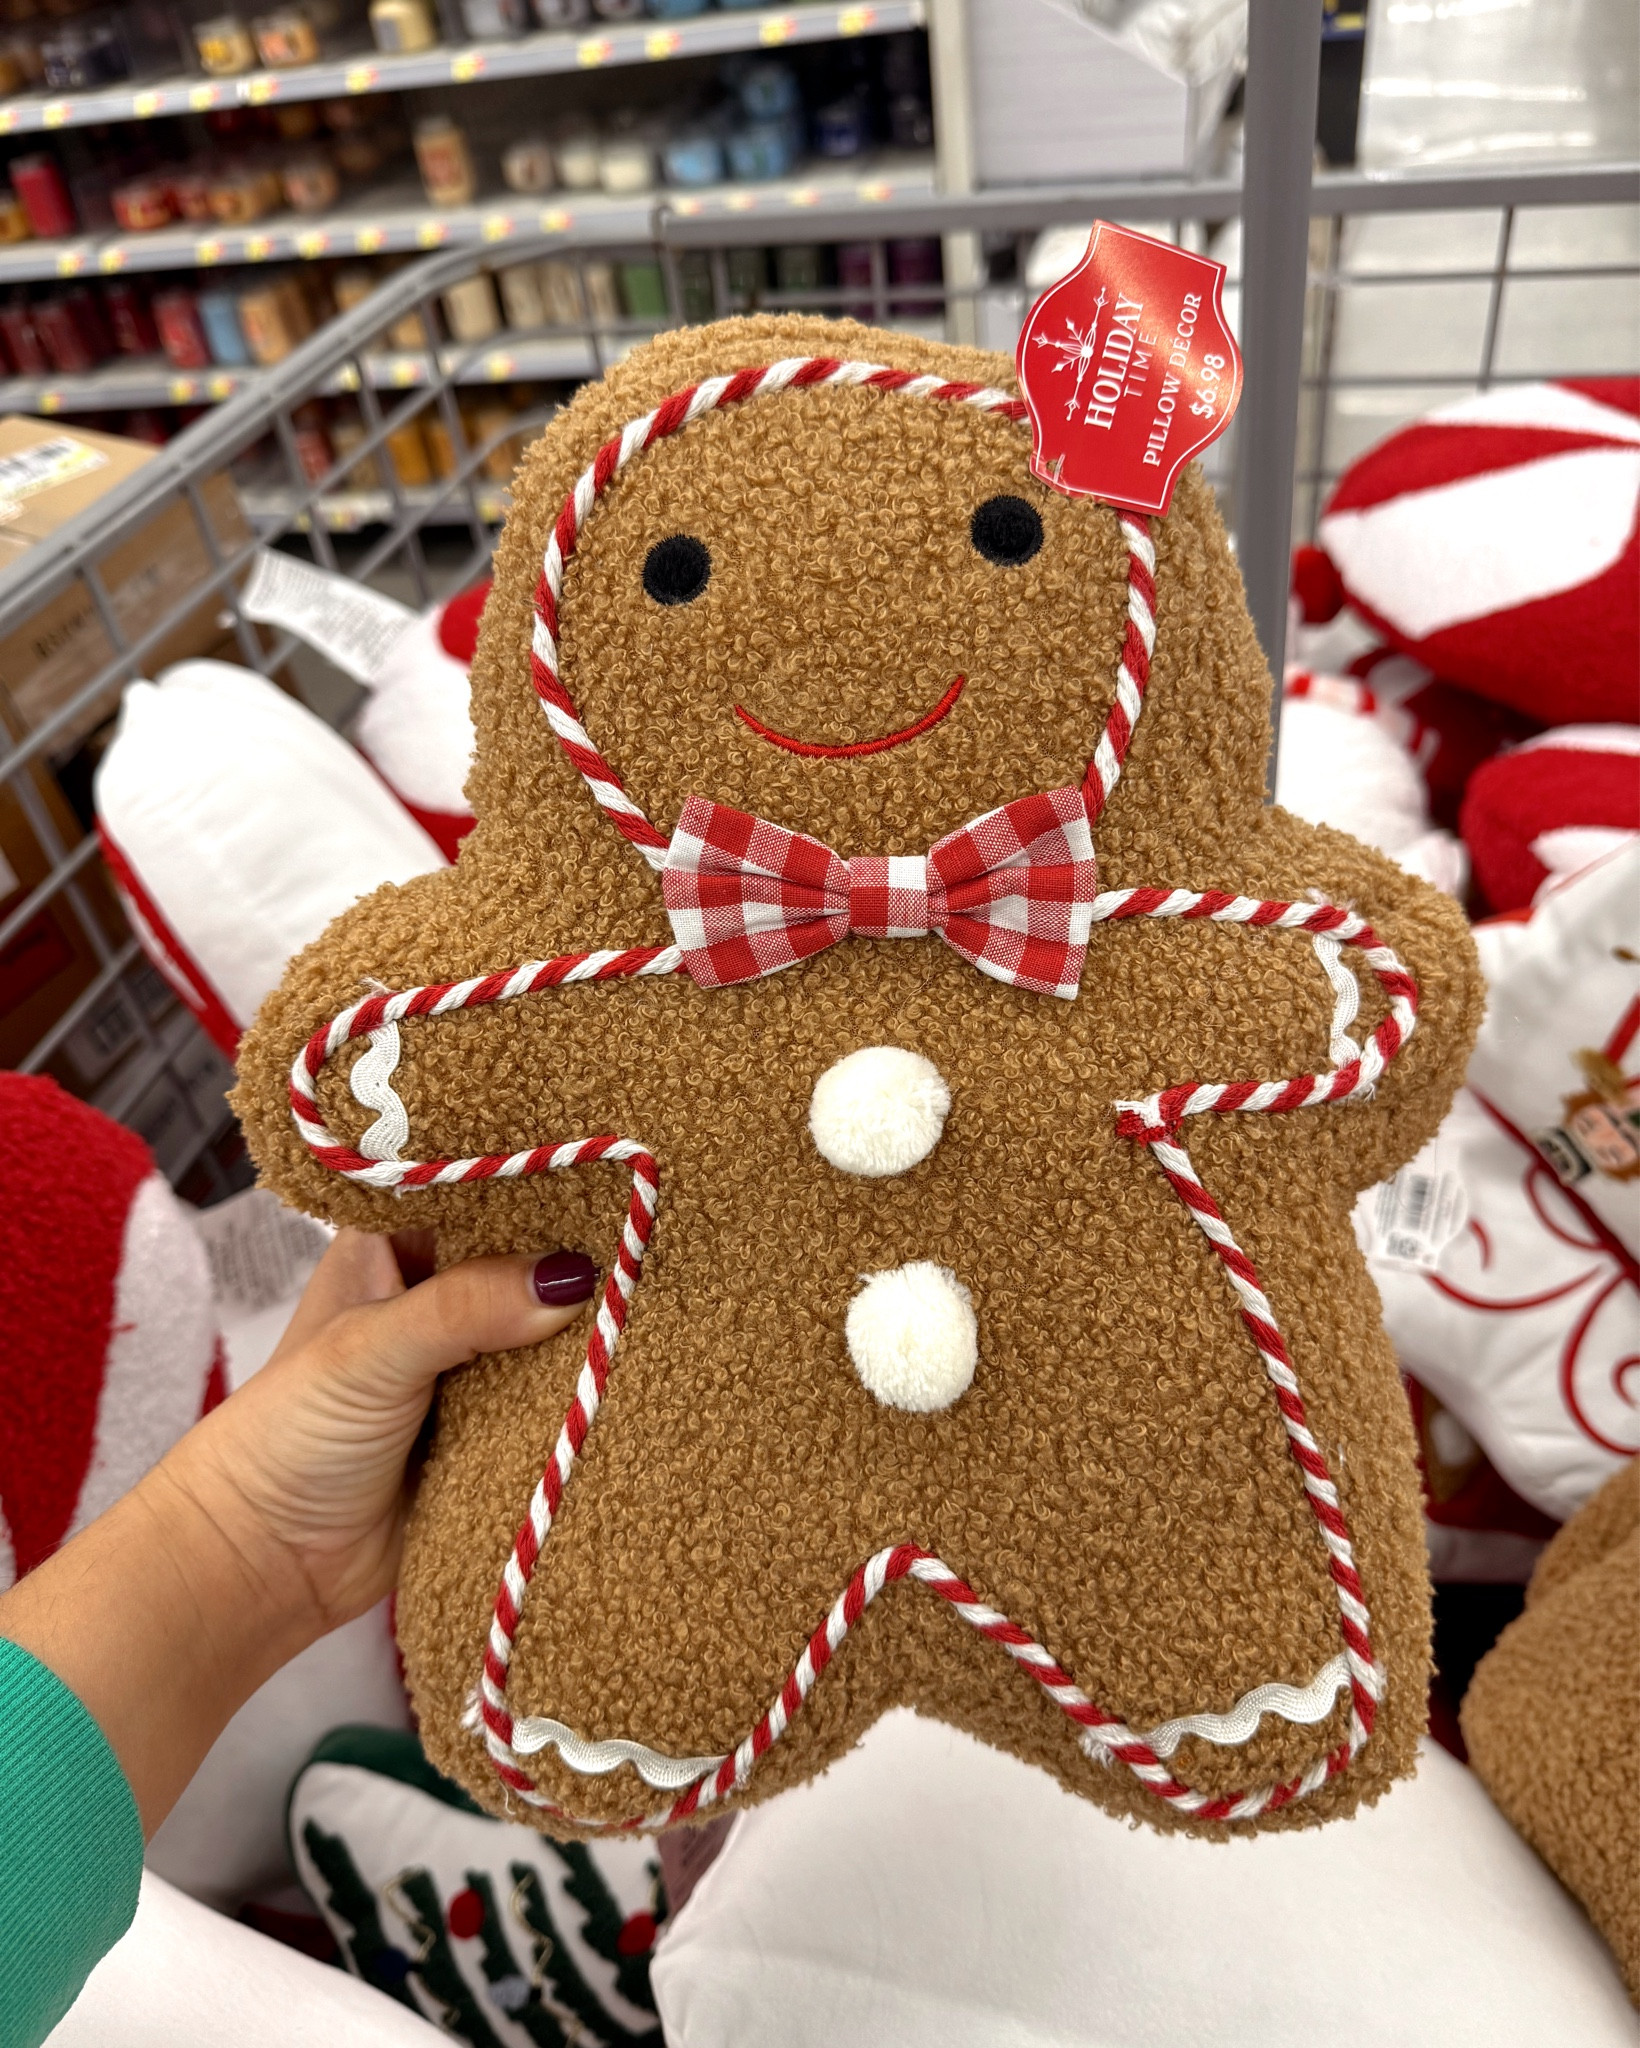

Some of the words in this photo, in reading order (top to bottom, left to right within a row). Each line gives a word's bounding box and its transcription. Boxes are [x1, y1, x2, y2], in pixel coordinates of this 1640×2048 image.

[1084, 292, 1144, 430] HOLIDAY
[1124, 332, 1157, 398] TIME
[1190, 353, 1225, 419] $6.98
[1142, 371, 1182, 467] PILLOW
